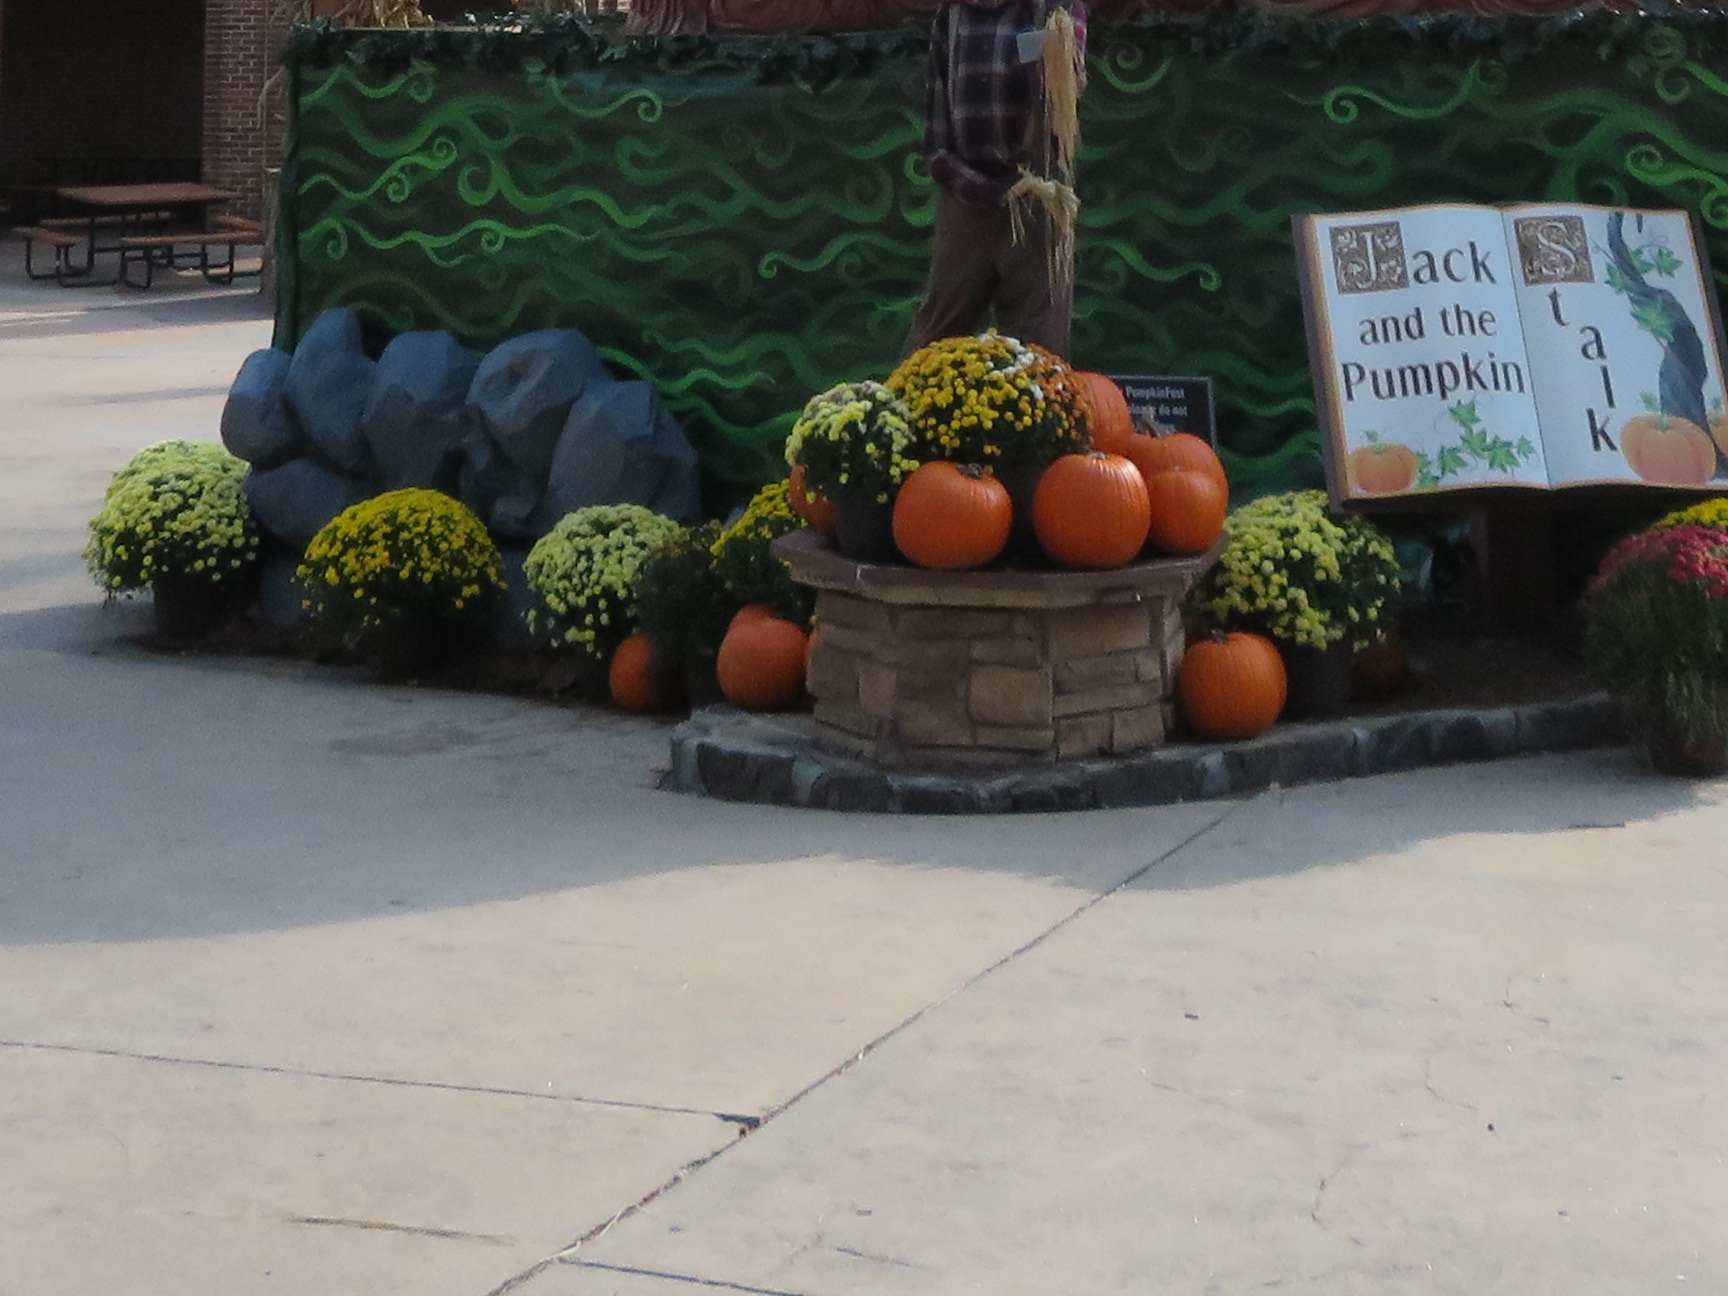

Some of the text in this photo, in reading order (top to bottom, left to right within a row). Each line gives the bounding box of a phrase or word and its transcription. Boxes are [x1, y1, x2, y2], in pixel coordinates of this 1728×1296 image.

[1352, 229, 1497, 291] Jack
[1359, 302, 1498, 346] and the
[1126, 385, 1185, 400] PumpkinFest
[1341, 351, 1525, 403] Pumpkin
